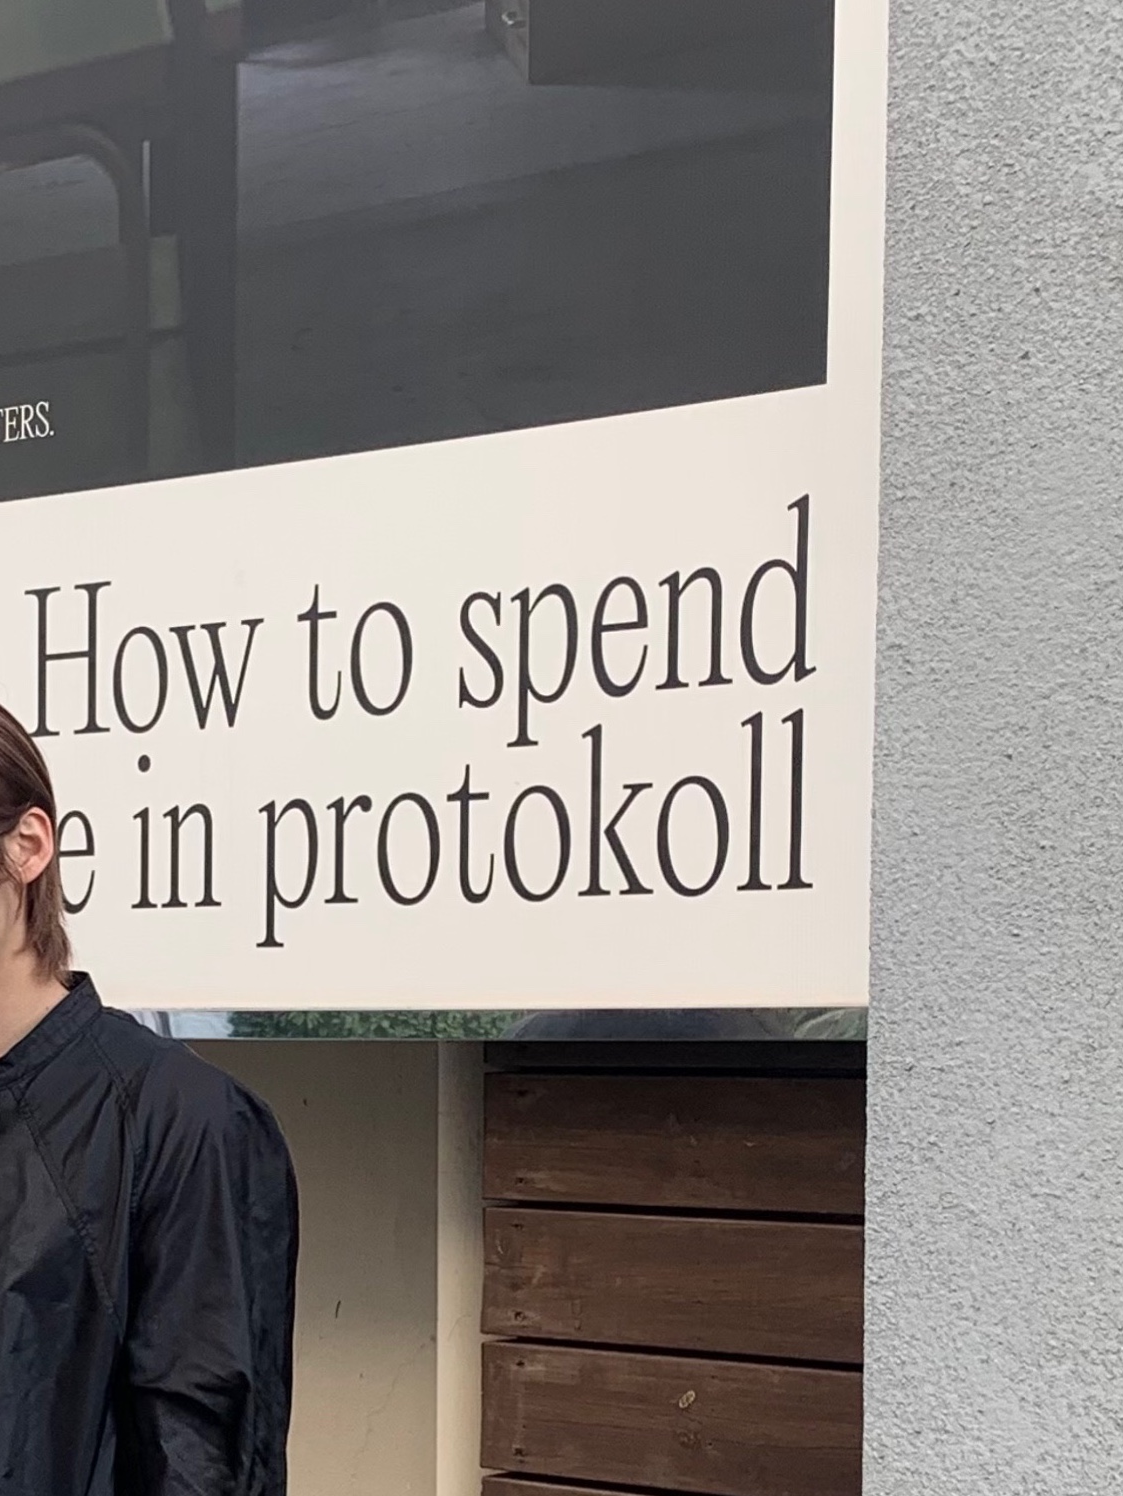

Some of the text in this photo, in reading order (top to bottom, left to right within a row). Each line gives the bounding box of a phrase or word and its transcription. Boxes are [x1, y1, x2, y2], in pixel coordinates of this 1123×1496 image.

[25, 493, 817, 748] How to spend
[131, 754, 223, 910] in
[255, 707, 815, 949] protokoll
